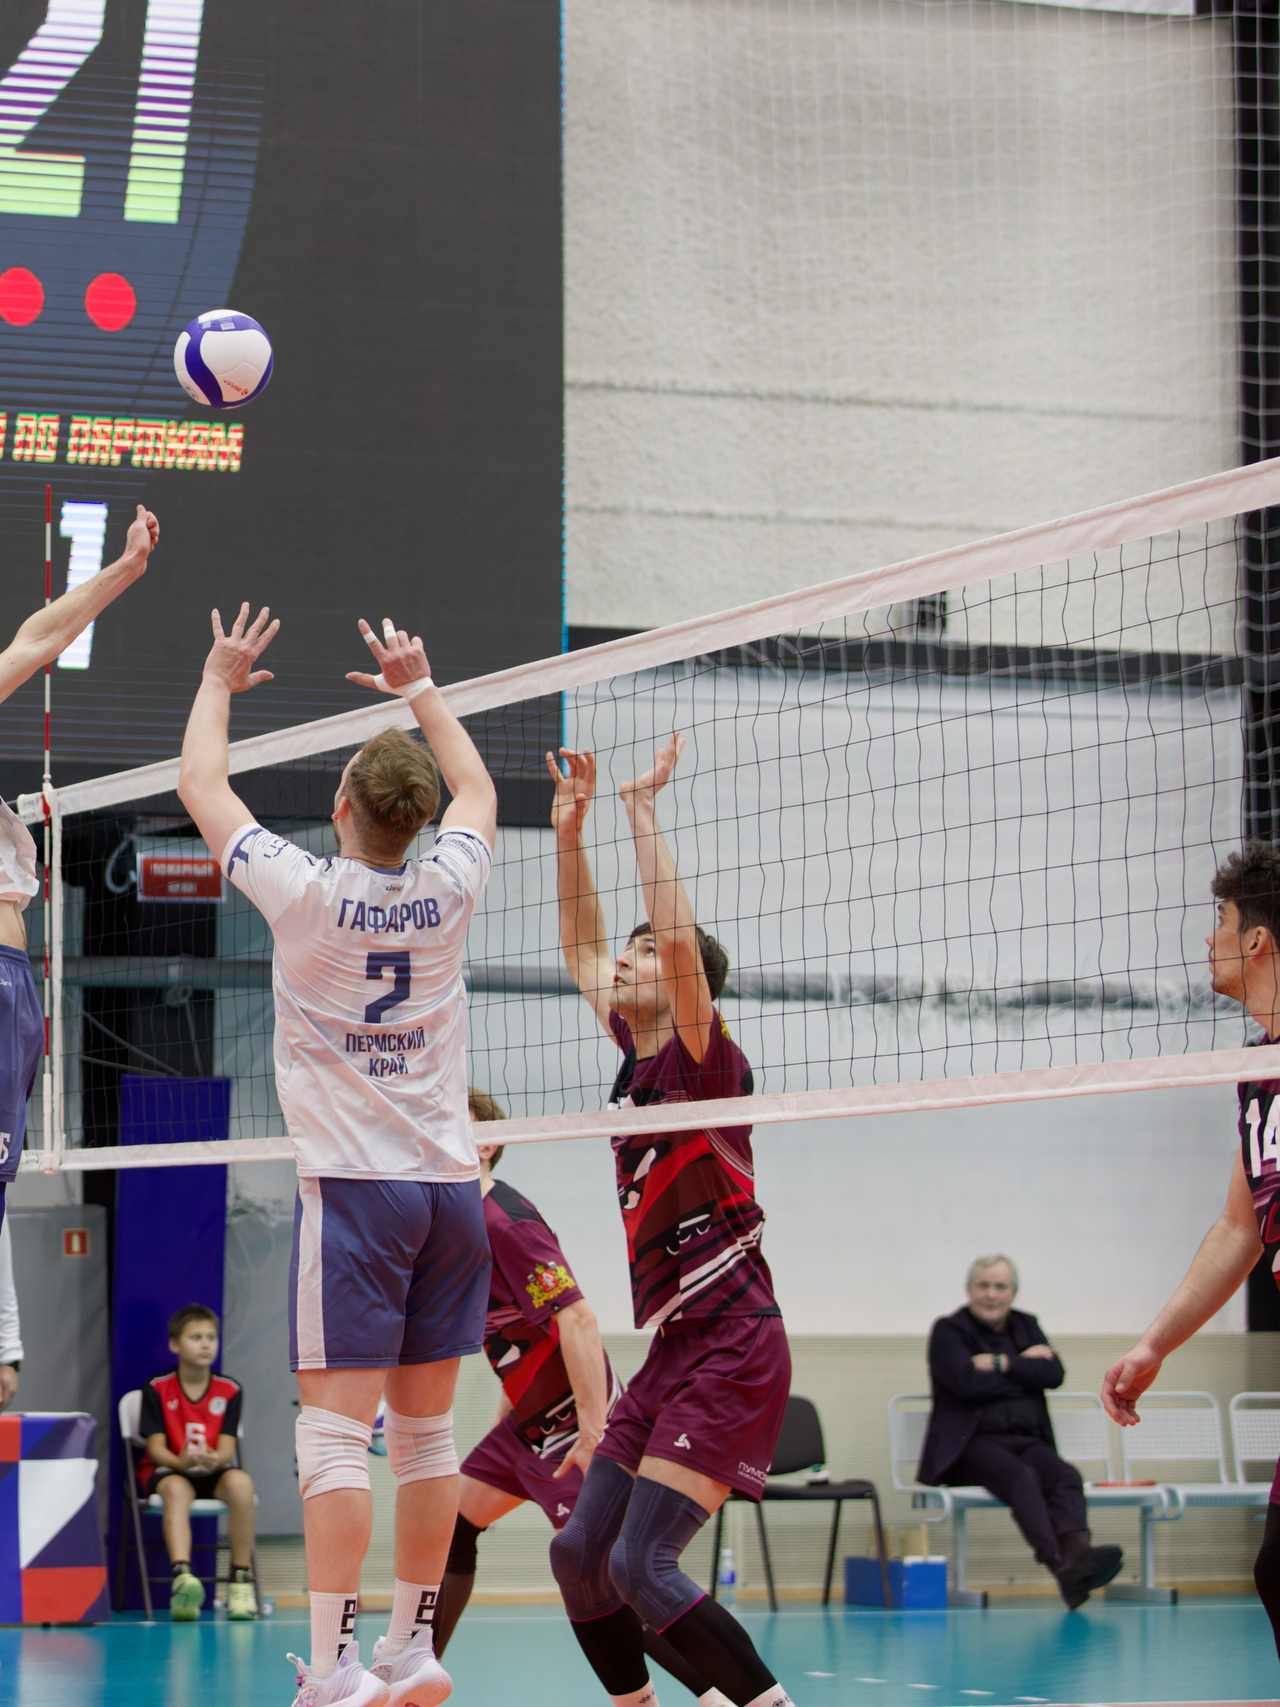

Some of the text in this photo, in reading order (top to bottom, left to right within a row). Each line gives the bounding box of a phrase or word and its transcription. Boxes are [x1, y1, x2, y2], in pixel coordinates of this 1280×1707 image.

[12, 412, 60, 463] ПО
[66, 415, 245, 472] ПАРТИЯМ
[57, 501, 109, 670] 1
[337, 898, 441, 934] ГАФАРОВ
[364, 951, 413, 1023] 7
[345, 1026, 426, 1053] ПЕРМСКИЙ
[369, 1053, 409, 1077] КРАЙ
